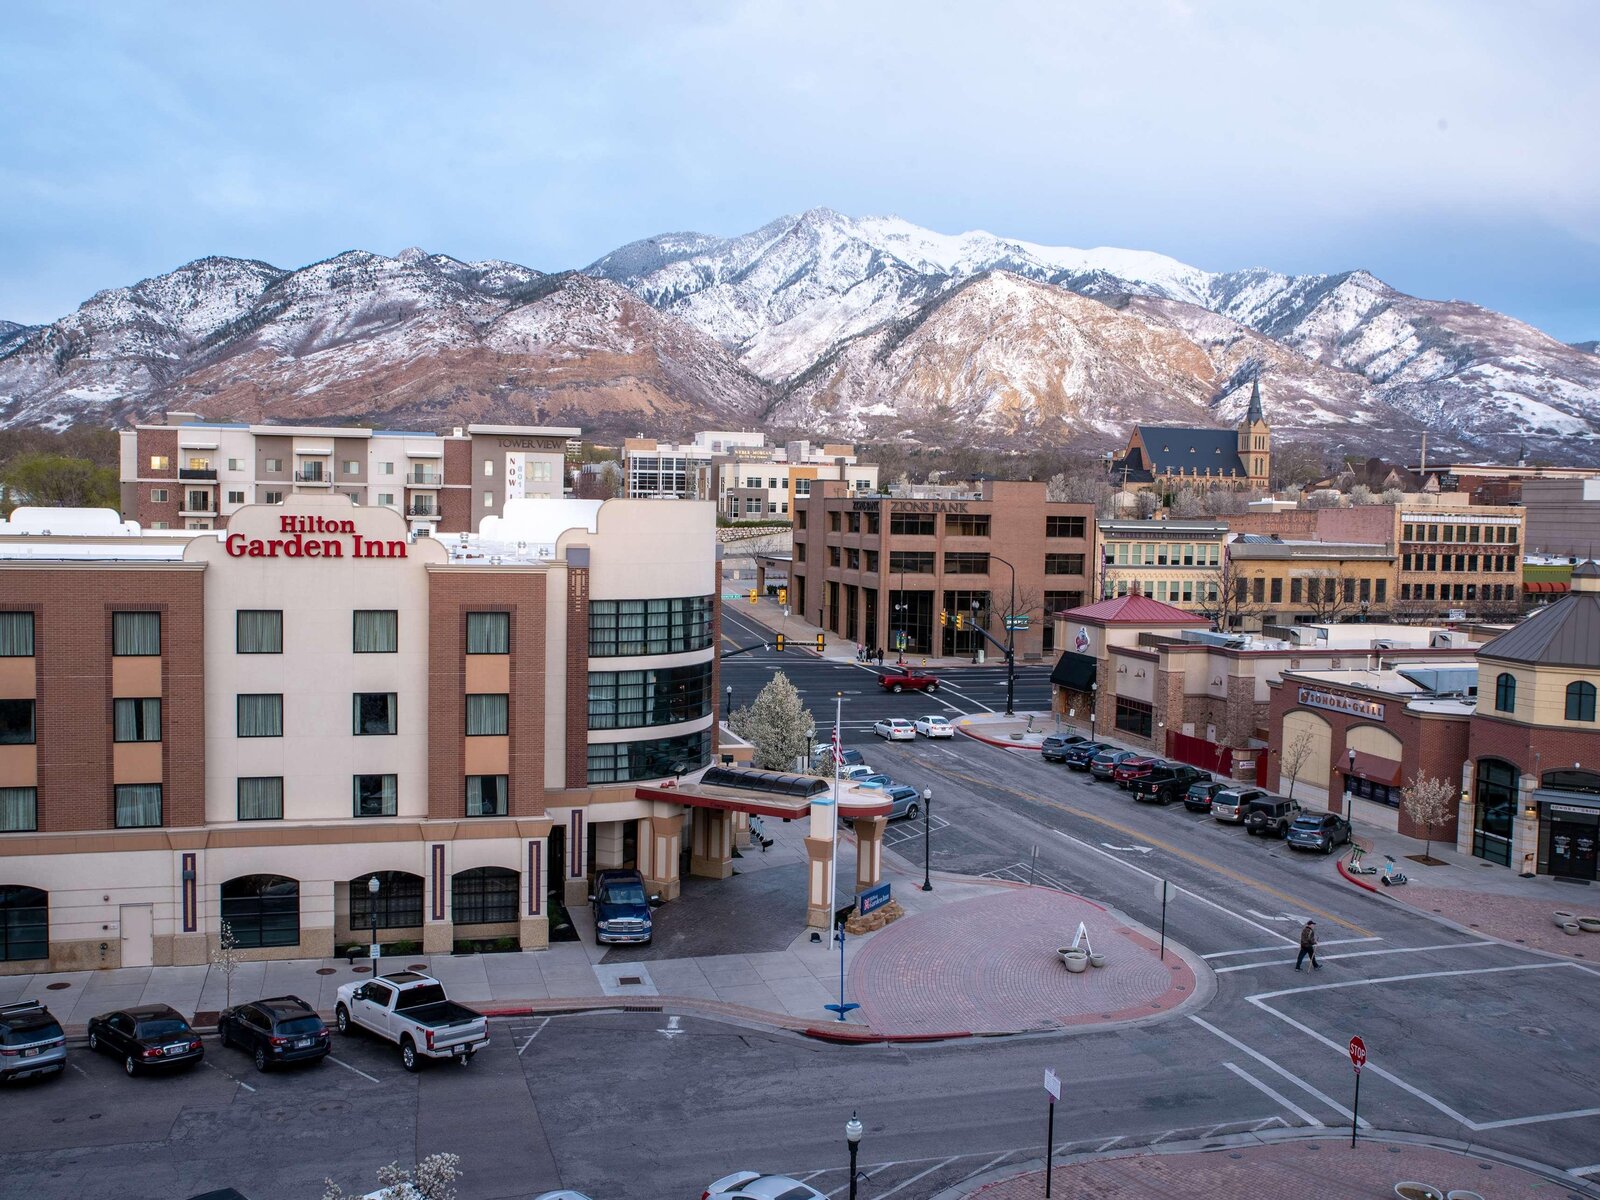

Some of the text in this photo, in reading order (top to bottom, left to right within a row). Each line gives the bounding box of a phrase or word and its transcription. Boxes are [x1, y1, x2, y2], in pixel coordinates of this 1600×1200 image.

[497, 439, 562, 449] TOWER VIEW
[890, 501, 969, 513] ZIONS BANK
[280, 516, 356, 533] Hilton
[225, 534, 408, 558] Garden Inn
[1311, 694, 1382, 717] SONORA GRILL
[1350, 1043, 1366, 1060] STOP
